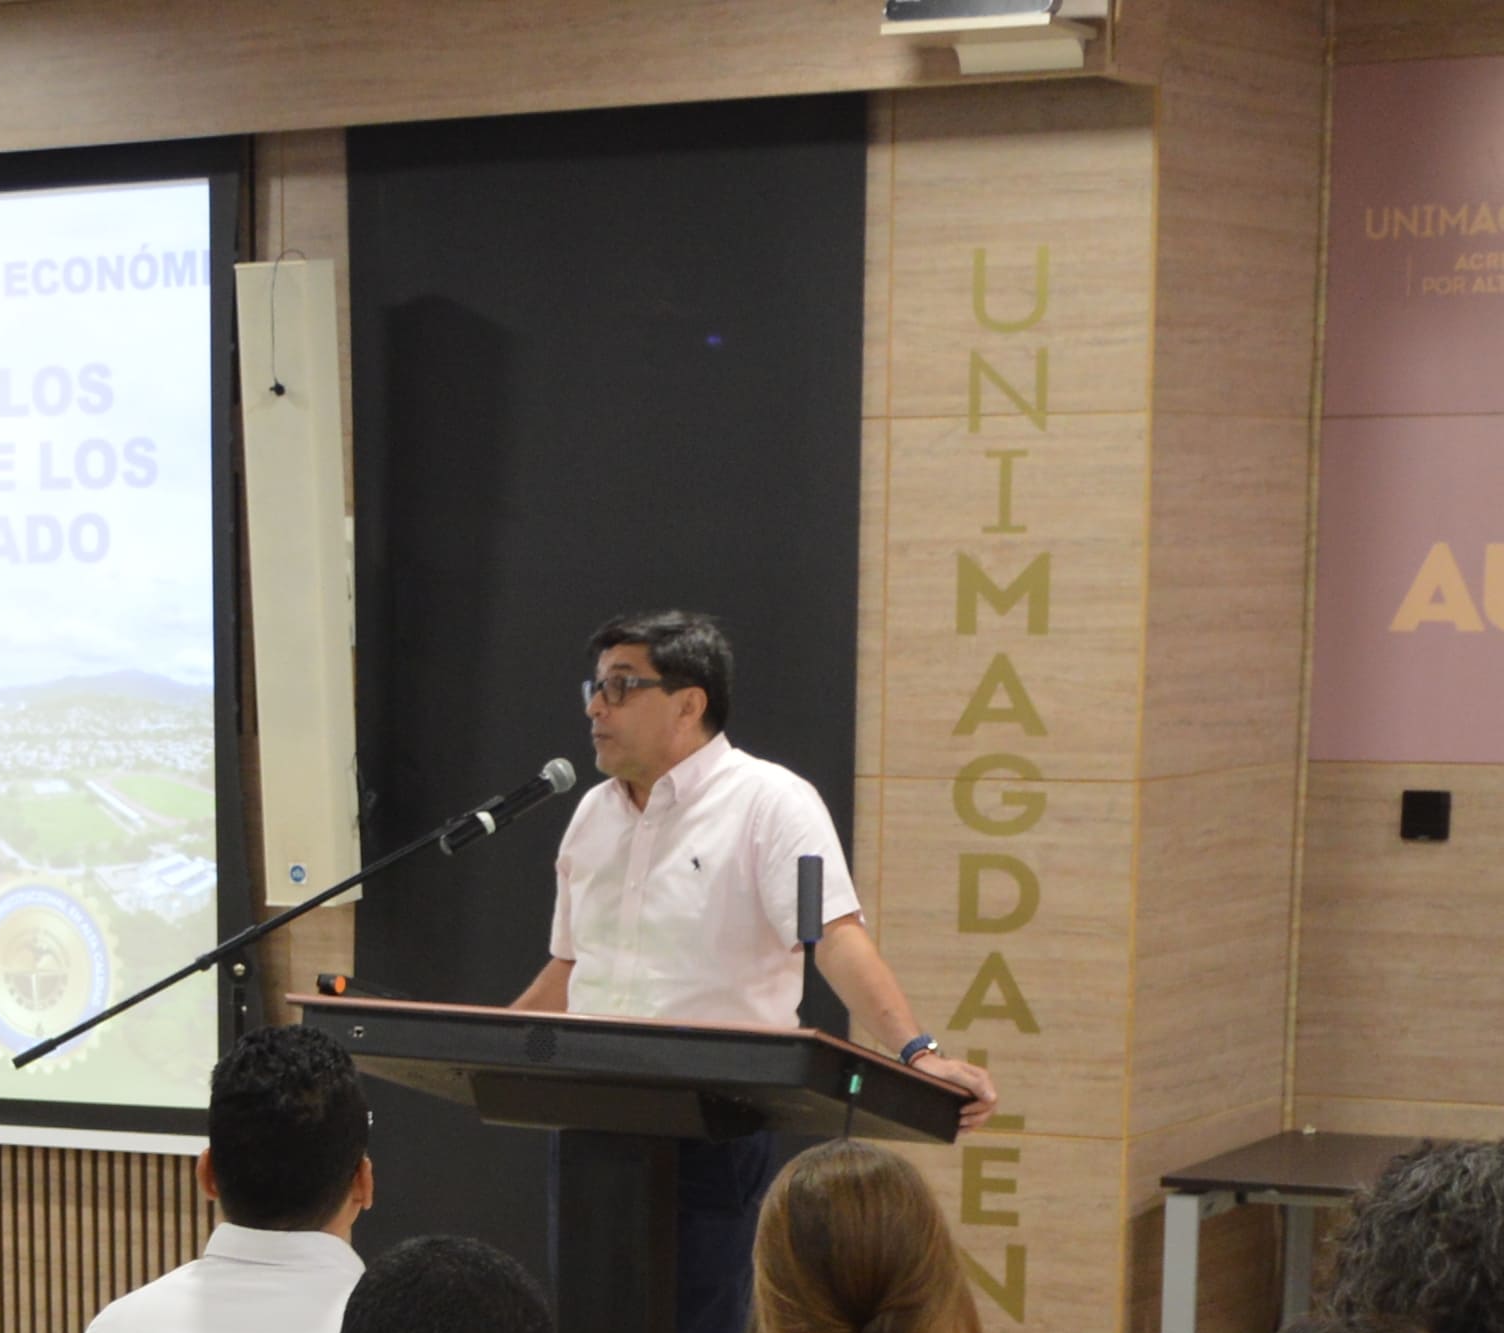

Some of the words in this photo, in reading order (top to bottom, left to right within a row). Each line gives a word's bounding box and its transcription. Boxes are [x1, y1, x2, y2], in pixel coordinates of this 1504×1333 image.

[3, 242, 210, 297] ECONÓMI
[1422, 275, 1465, 295] POR
[38, 435, 160, 490] LOS
